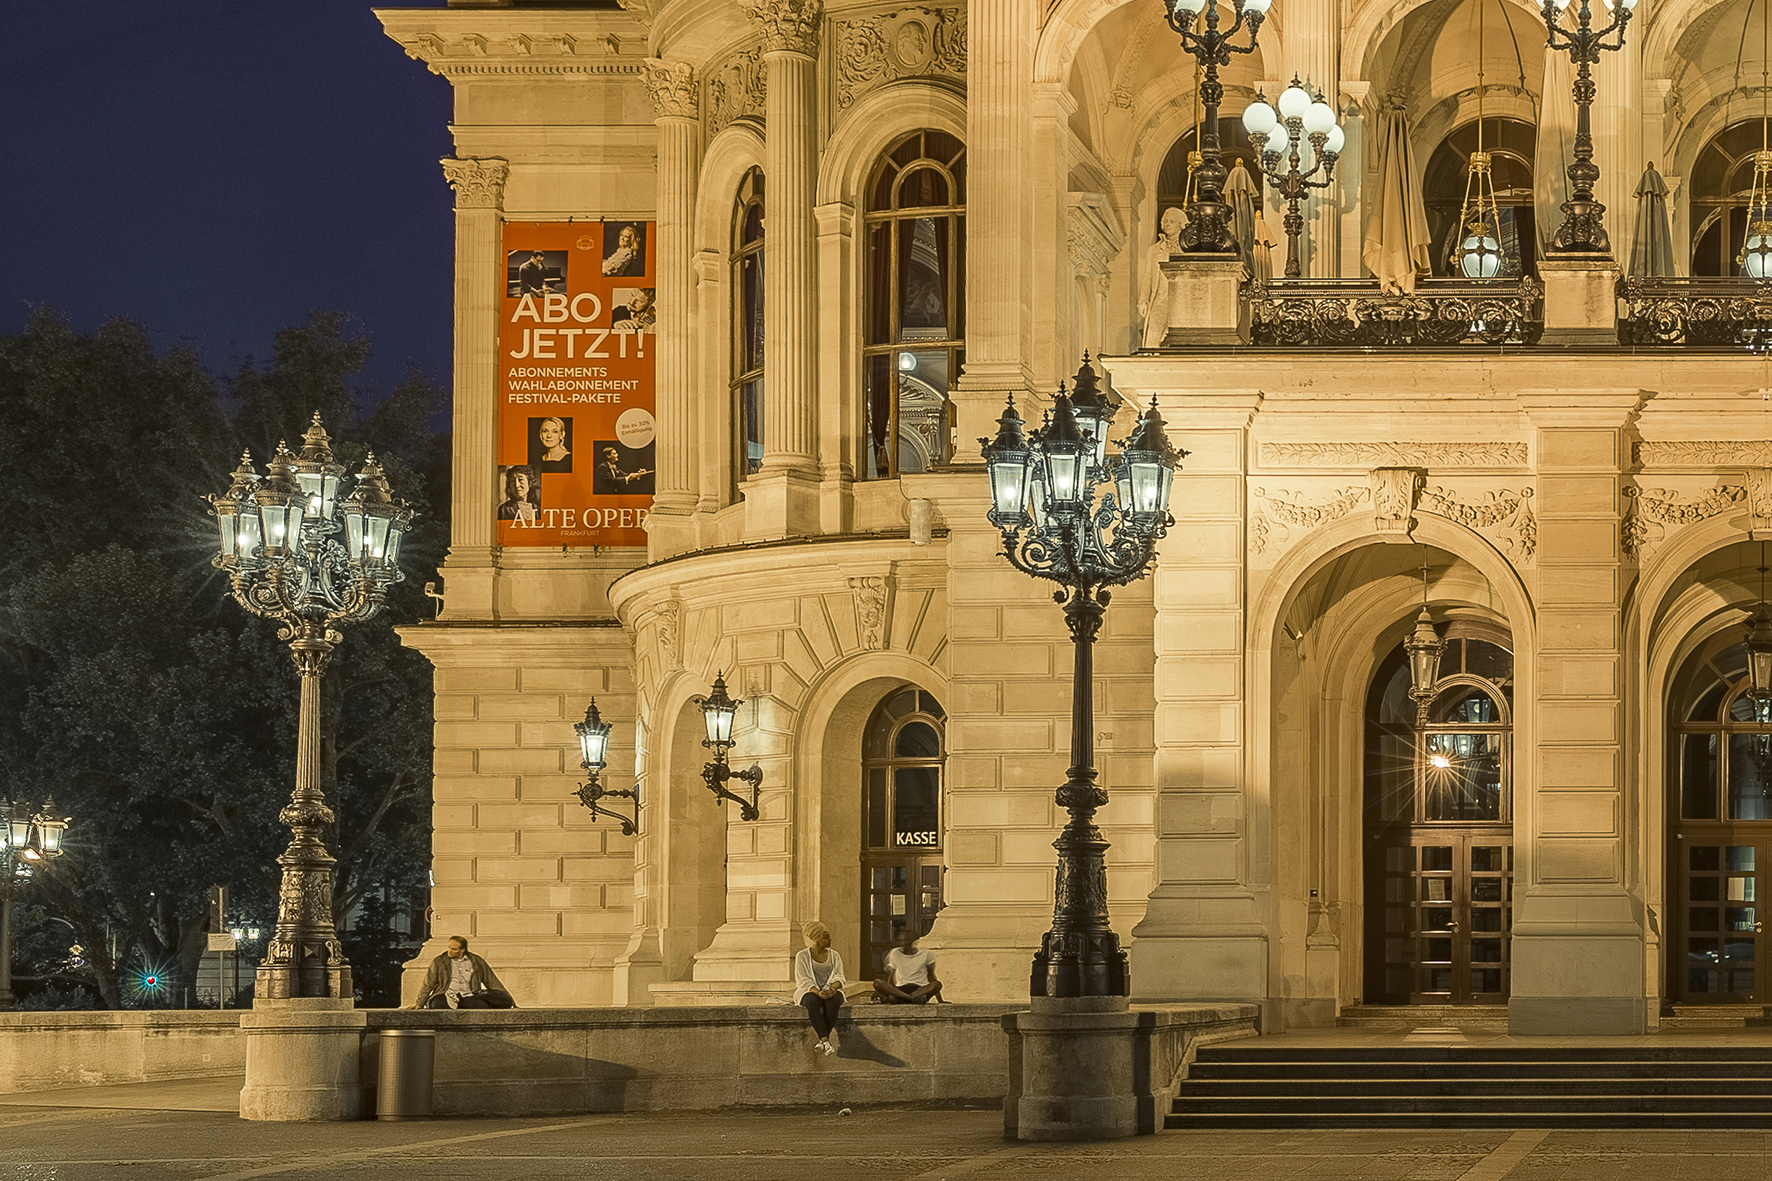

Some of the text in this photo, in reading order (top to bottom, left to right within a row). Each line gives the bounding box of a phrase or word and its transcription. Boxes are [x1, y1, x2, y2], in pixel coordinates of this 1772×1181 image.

[510, 293, 602, 324] ABO
[509, 328, 644, 359] JETZT!
[508, 367, 608, 378] ABONNEMENTS
[508, 380, 639, 391] WAHLABONNEMENT
[508, 393, 621, 404] FESTIVAL-PAKETE
[510, 508, 577, 529] ALTE
[896, 831, 937, 845] KASSE
